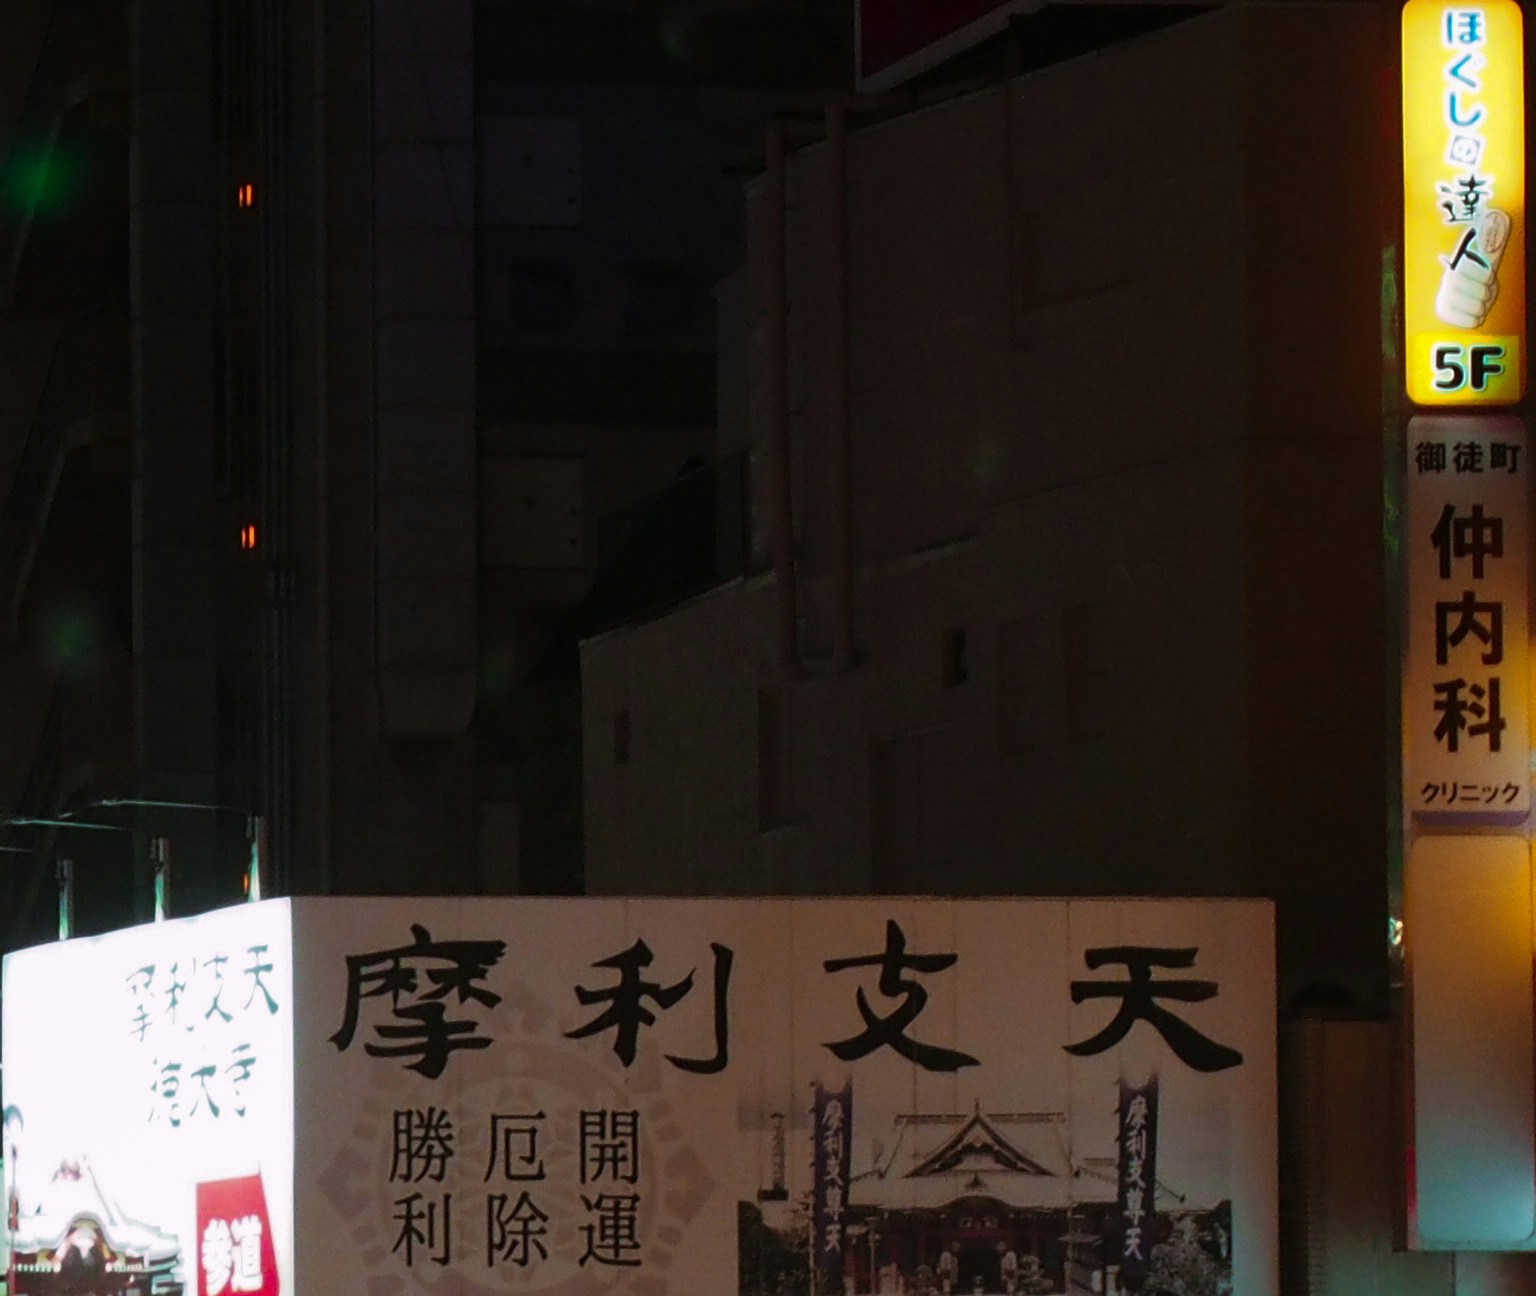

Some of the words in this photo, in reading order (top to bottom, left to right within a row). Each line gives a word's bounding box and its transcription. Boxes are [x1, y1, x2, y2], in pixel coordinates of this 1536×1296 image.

[1434, 345, 1505, 391] 5F
[1415, 441, 1522, 474] 御徒町
[1430, 503, 1506, 753] 仲内科
[1420, 782, 1521, 805] クリニック
[331, 922, 1244, 1077] 摩利支天
